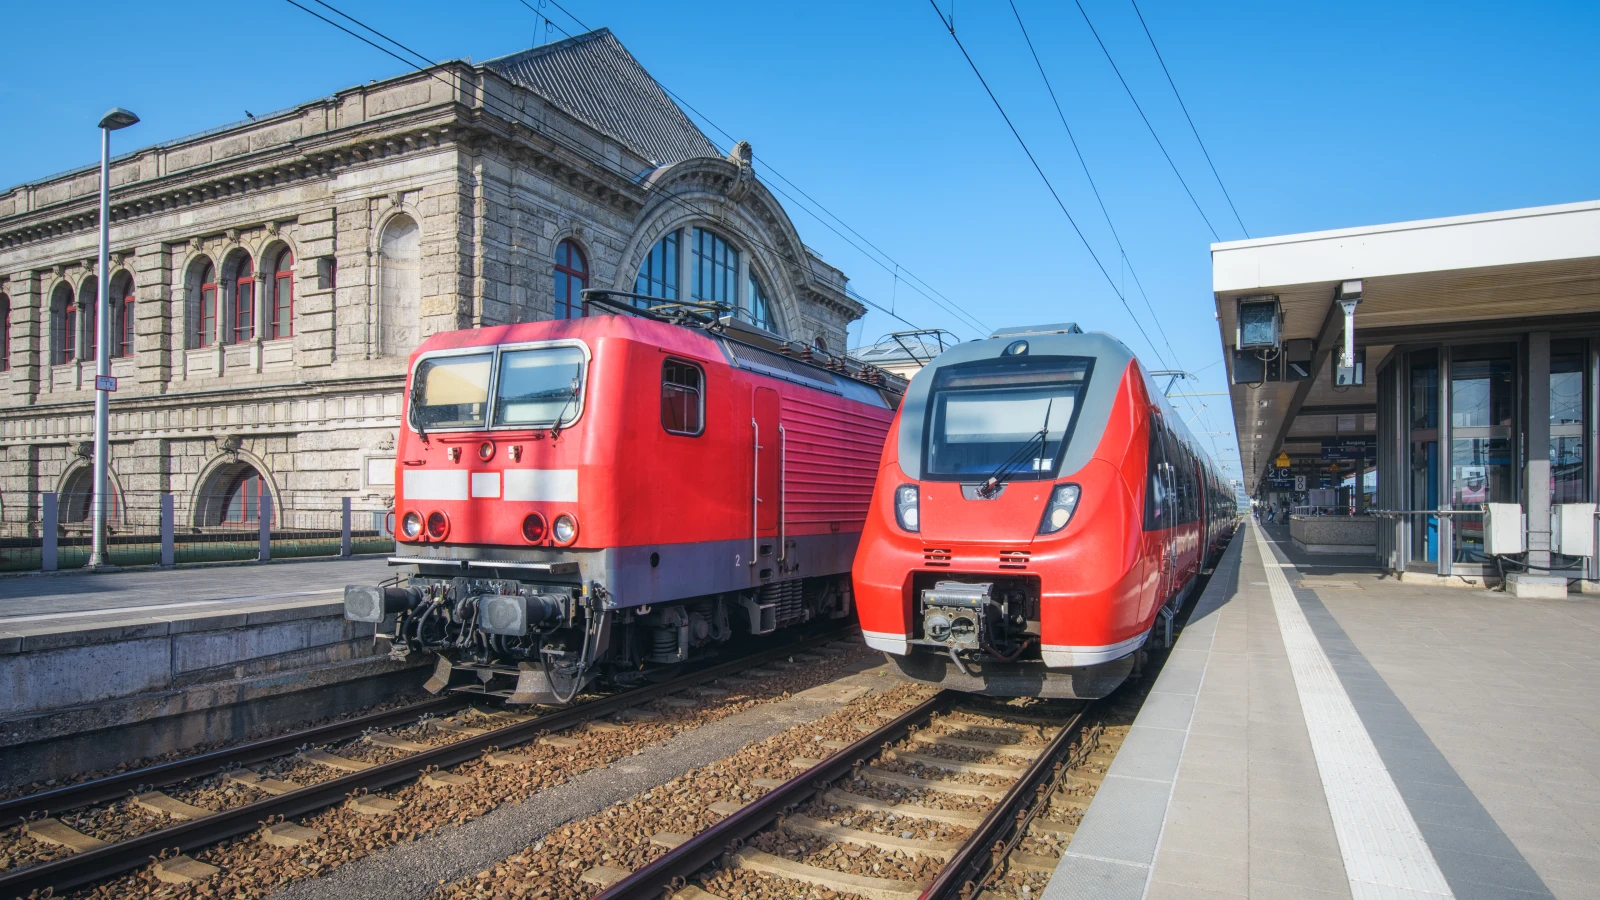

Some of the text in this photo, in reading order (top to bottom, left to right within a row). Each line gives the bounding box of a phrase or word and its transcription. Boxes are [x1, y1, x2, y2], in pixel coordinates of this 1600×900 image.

[1269, 468, 1274, 478] 2
[1280, 468, 1288, 477] C
[736, 554, 740, 566] 2
